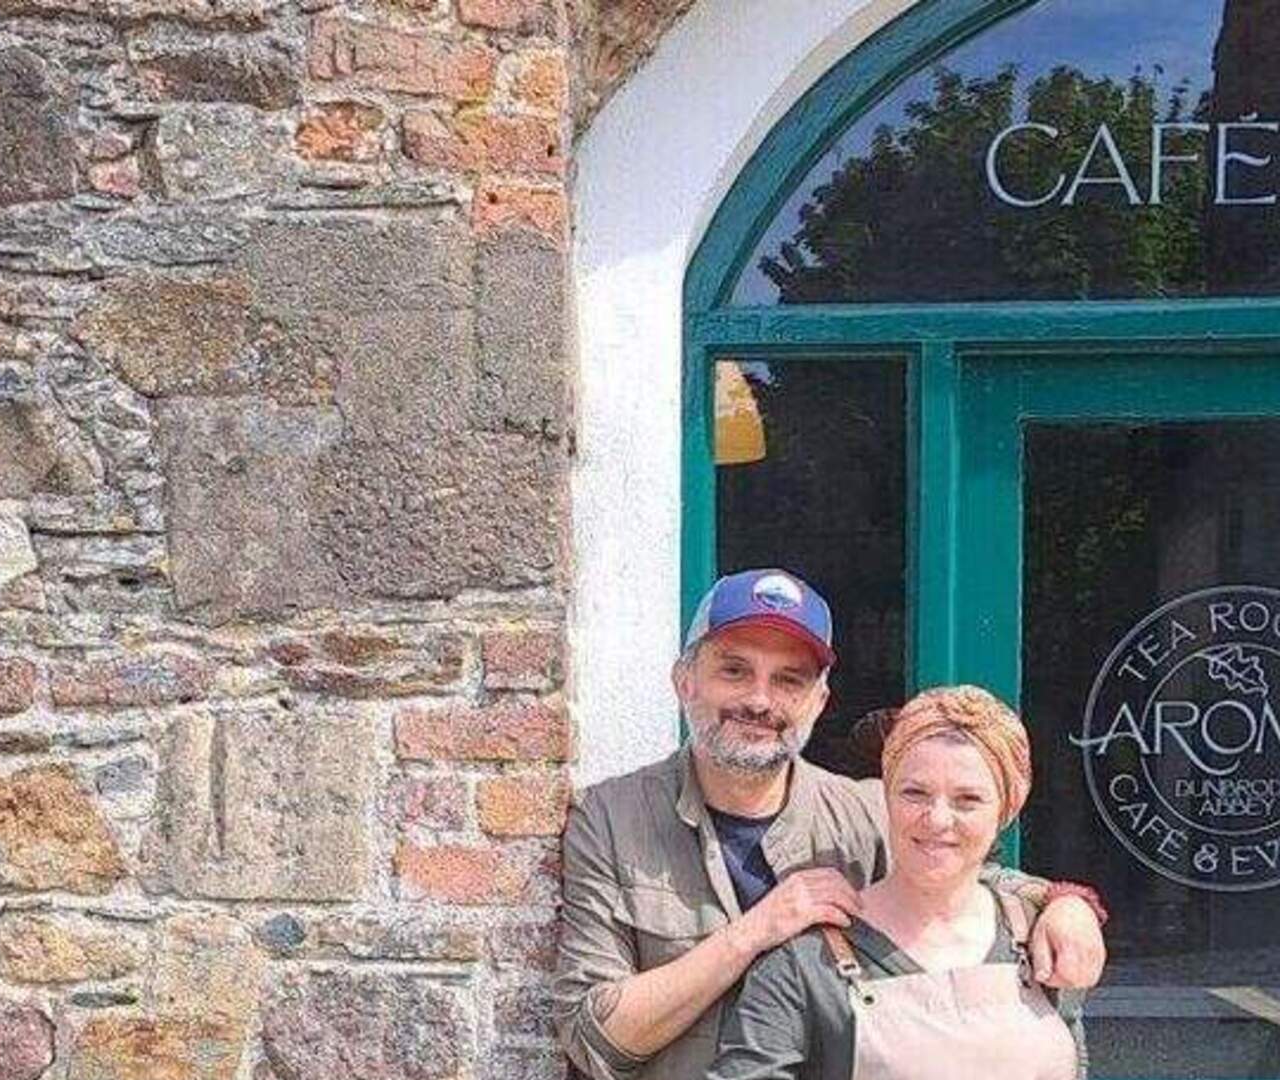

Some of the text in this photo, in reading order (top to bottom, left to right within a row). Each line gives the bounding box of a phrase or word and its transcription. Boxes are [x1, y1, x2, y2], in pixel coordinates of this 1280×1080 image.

[985, 111, 1280, 207] CAFÉ
[1118, 621, 1197, 682] TEA
[1193, 843, 1219, 873] &
